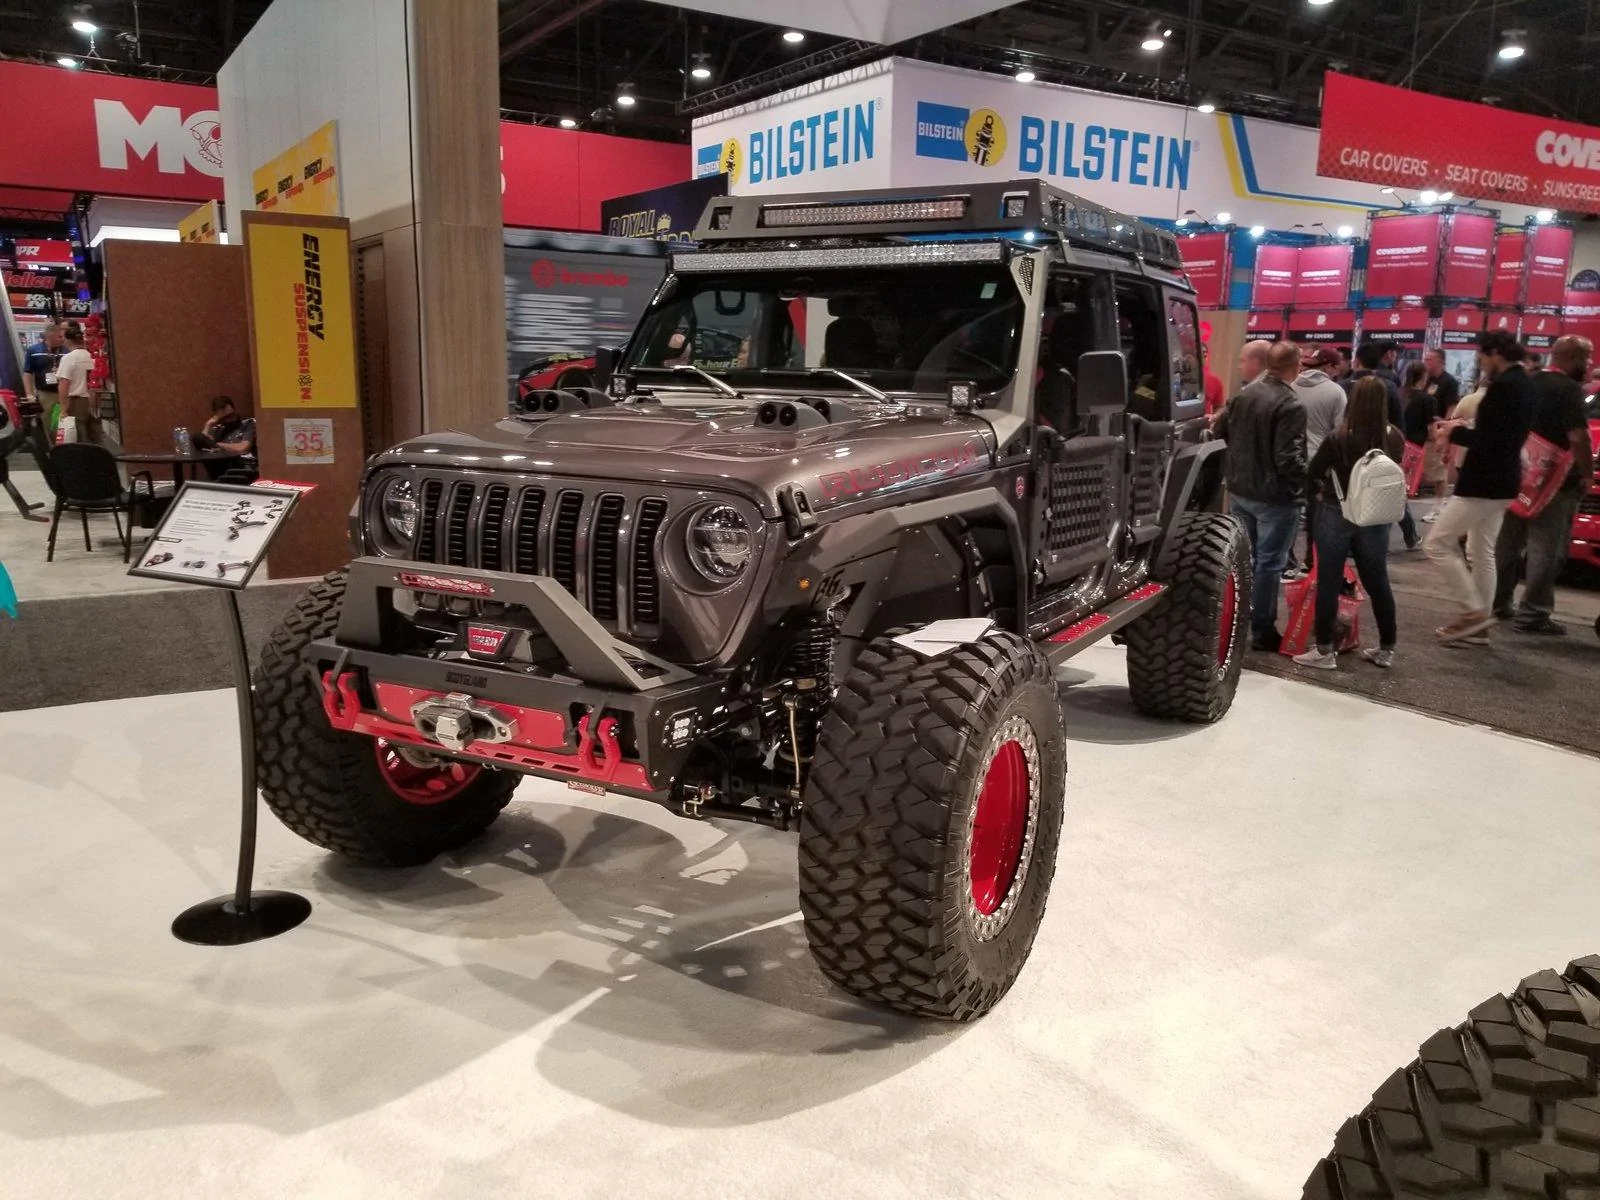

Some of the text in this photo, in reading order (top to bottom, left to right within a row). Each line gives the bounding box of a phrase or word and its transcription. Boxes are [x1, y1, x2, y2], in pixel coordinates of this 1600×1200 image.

[750, 99, 875, 184] BILSTEIN
[918, 120, 963, 142] BILSTEIN
[1019, 115, 1191, 190] BILSTEIN
[1340, 147, 1370, 169] CAR
[1373, 152, 1428, 177] COVERS
[1445, 163, 1479, 185] SEAT
[1480, 170, 1528, 193] COVERS
[608, 209, 656, 238] ROYAL
[302, 232, 325, 342] ENERGY
[294, 432, 324, 451] 35
